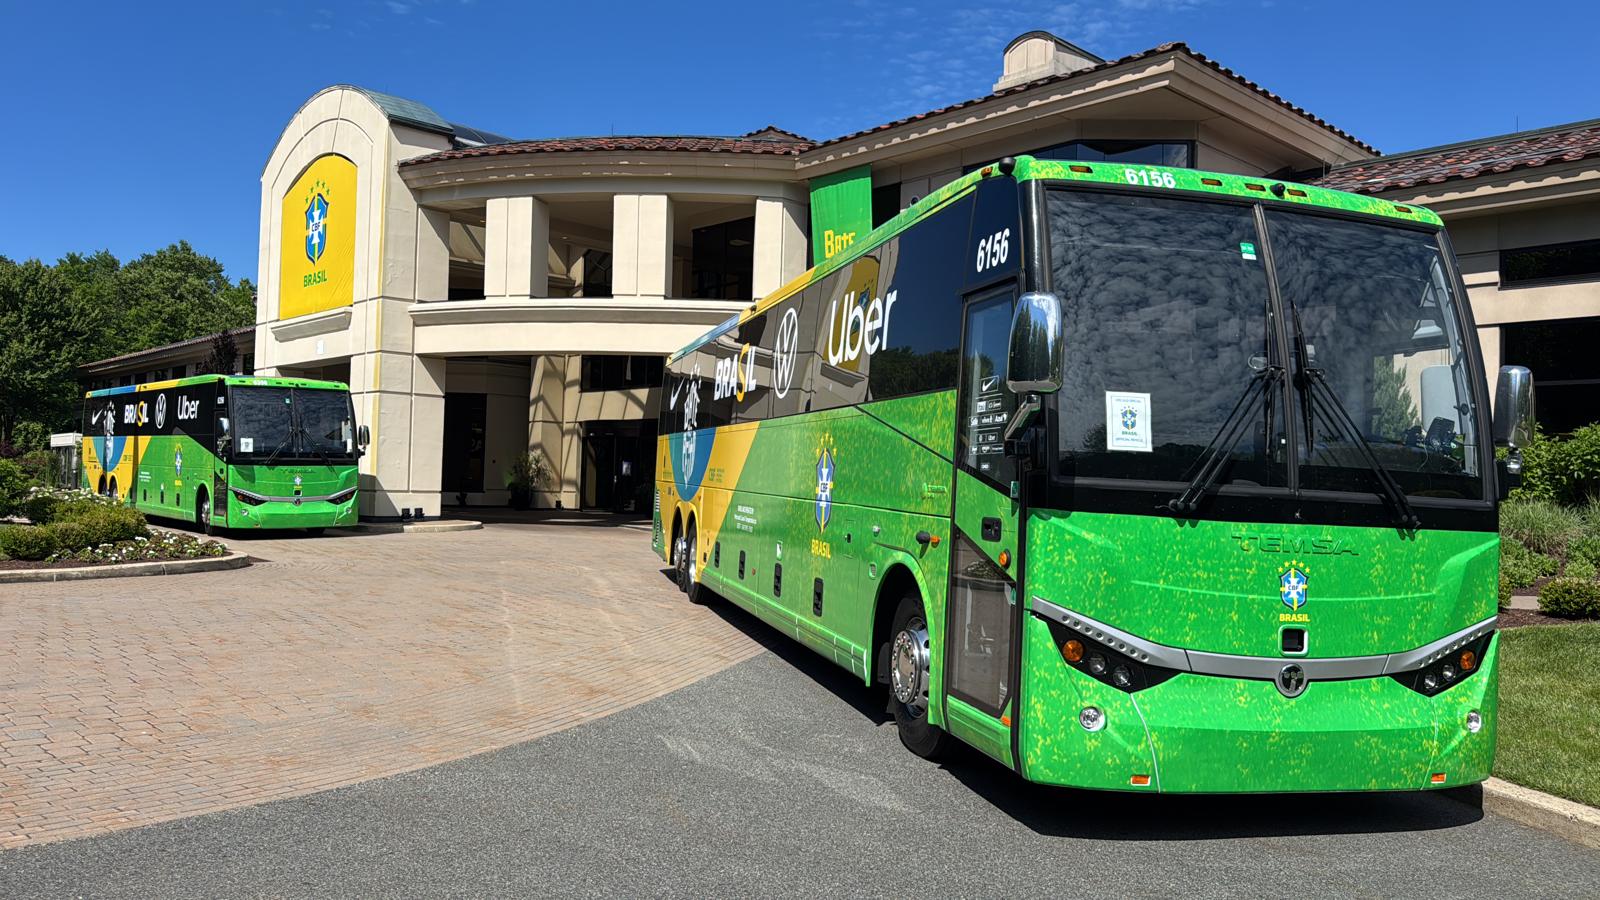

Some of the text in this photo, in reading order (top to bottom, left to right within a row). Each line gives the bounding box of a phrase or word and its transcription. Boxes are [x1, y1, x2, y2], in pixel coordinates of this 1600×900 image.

[1124, 168, 1177, 189] 6156
[311, 221, 321, 232] CBF
[976, 227, 1010, 273] 6156
[303, 270, 328, 288] BRASIL
[827, 289, 898, 367] Uber
[713, 342, 757, 403] BRASIL
[123, 400, 149, 427] BRASIL
[177, 395, 200, 420] Uber
[811, 538, 831, 560] BRASIL
[1231, 532, 1360, 556] TEMSA
[1279, 613, 1310, 622] BRASIL
